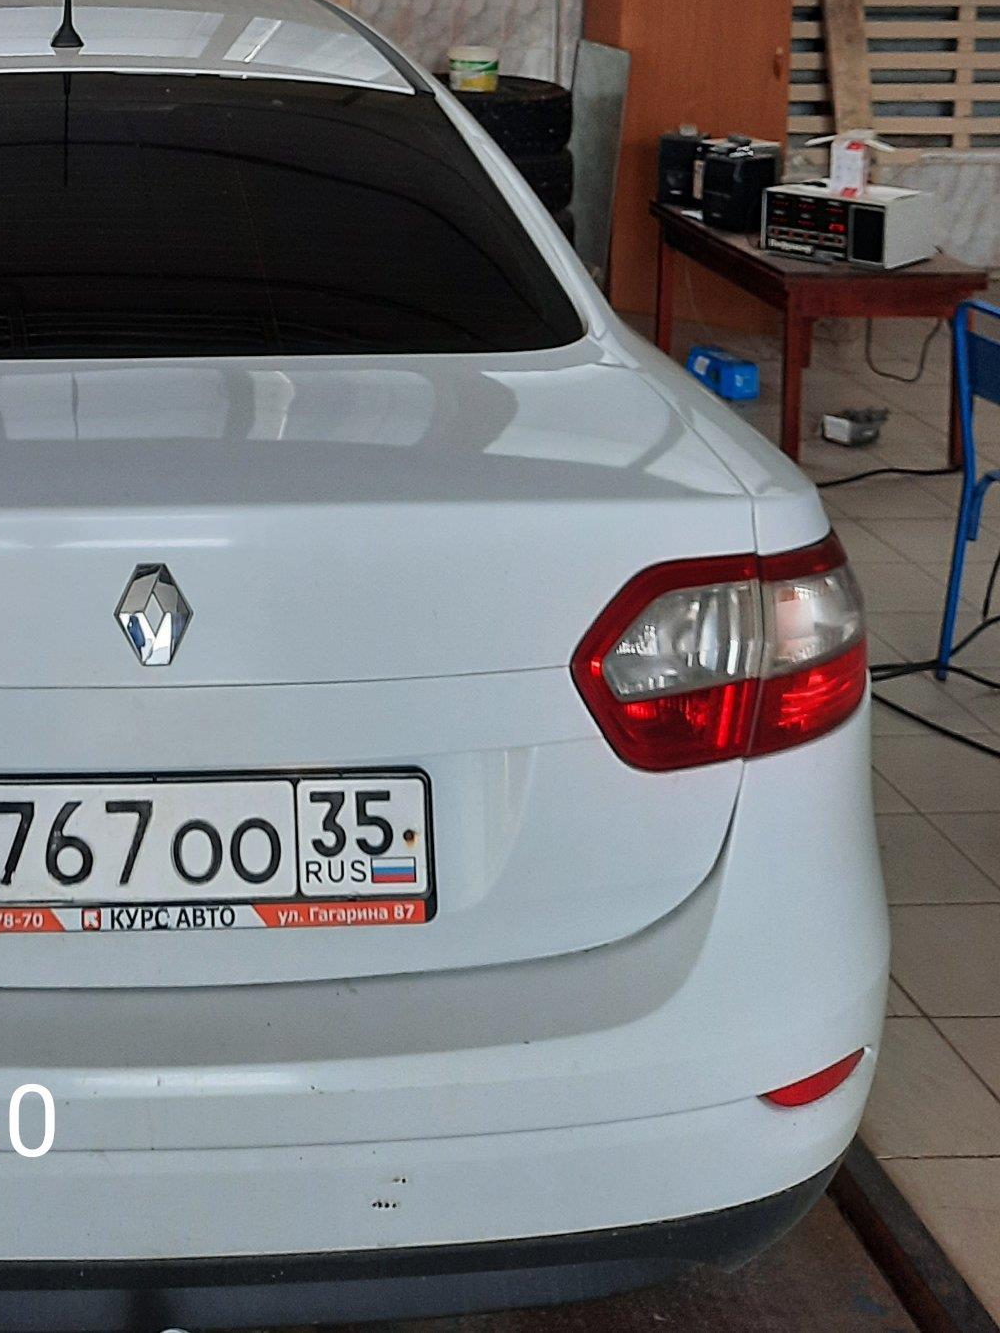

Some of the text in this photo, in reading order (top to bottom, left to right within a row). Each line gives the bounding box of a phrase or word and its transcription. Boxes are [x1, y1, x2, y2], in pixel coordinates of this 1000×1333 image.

[309, 790, 394, 858] 35
[305, 860, 367, 884] RUS
[110, 905, 236, 930] КУРС АВТО
[277, 903, 416, 926] ул. Гагарина 87
